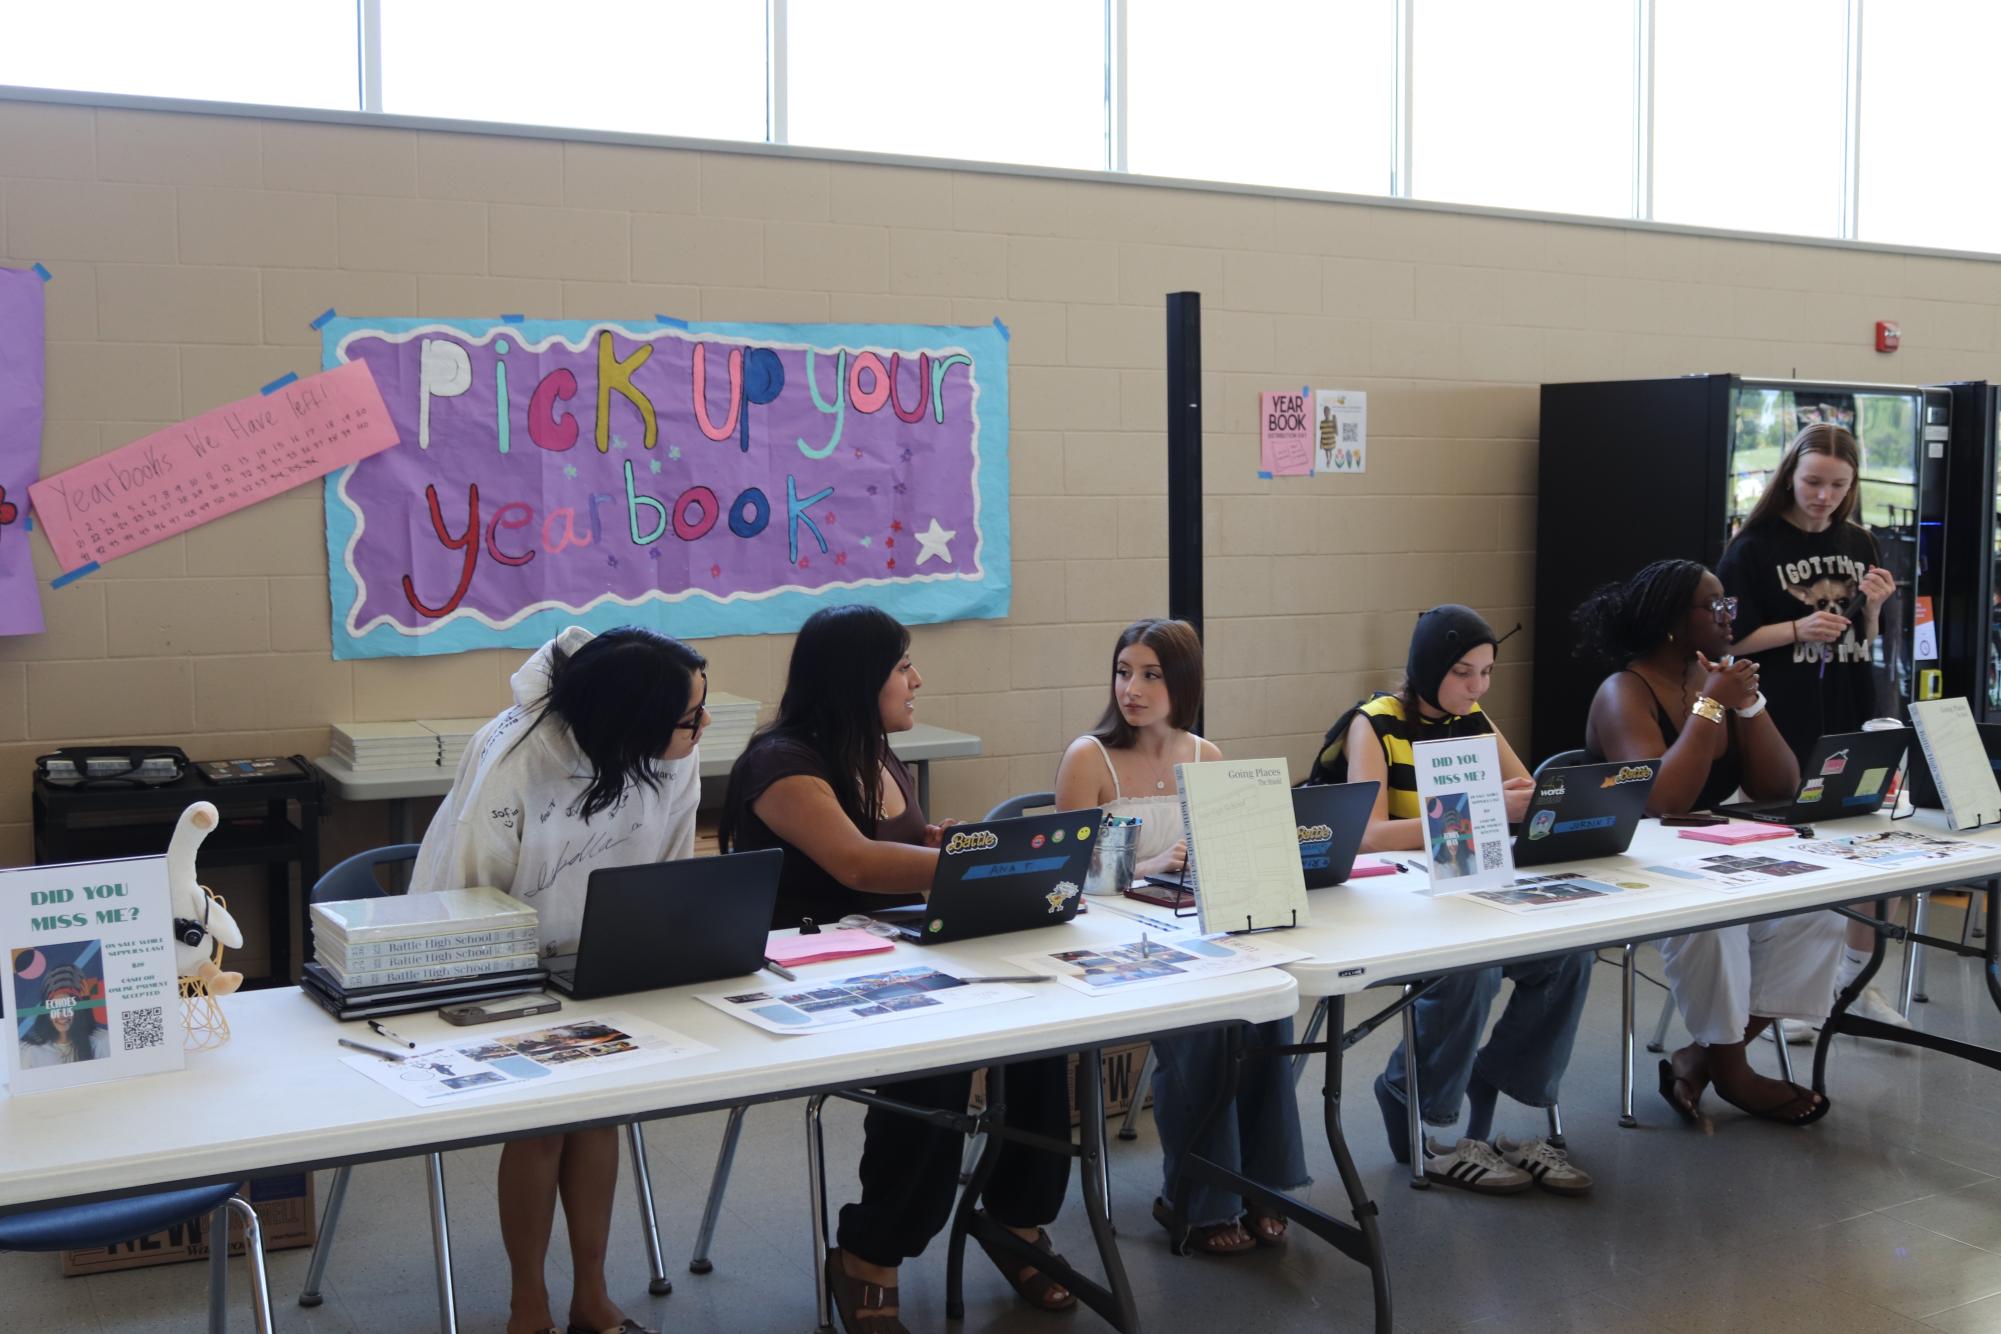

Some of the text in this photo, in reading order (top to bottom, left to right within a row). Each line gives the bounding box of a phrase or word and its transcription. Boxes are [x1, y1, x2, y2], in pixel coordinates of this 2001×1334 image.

[797, 346, 971, 459] your
[1272, 396, 1304, 413] YEAR
[1269, 413, 1306, 431] BOOK
[184, 426, 221, 458] We
[224, 411, 279, 440] Have
[1776, 565, 1788, 590] I
[1785, 556, 1822, 584] GOT
[1432, 754, 1478, 768] DID YOU
[1228, 768, 1281, 779] Going Places
[1433, 771, 1486, 785] MISS ME?
[951, 832, 996, 851] Battle
[30, 882, 129, 906] DID YOU
[31, 907, 140, 931] MISS ME?
[389, 941, 422, 953] Battle
[425, 938, 451, 950] High
[455, 932, 492, 945] School
[389, 945, 492, 967] Battle High School
[387, 960, 491, 982] Battle High School
[45, 996, 77, 1009] ECHOES
[62, 1007, 75, 1018] US
